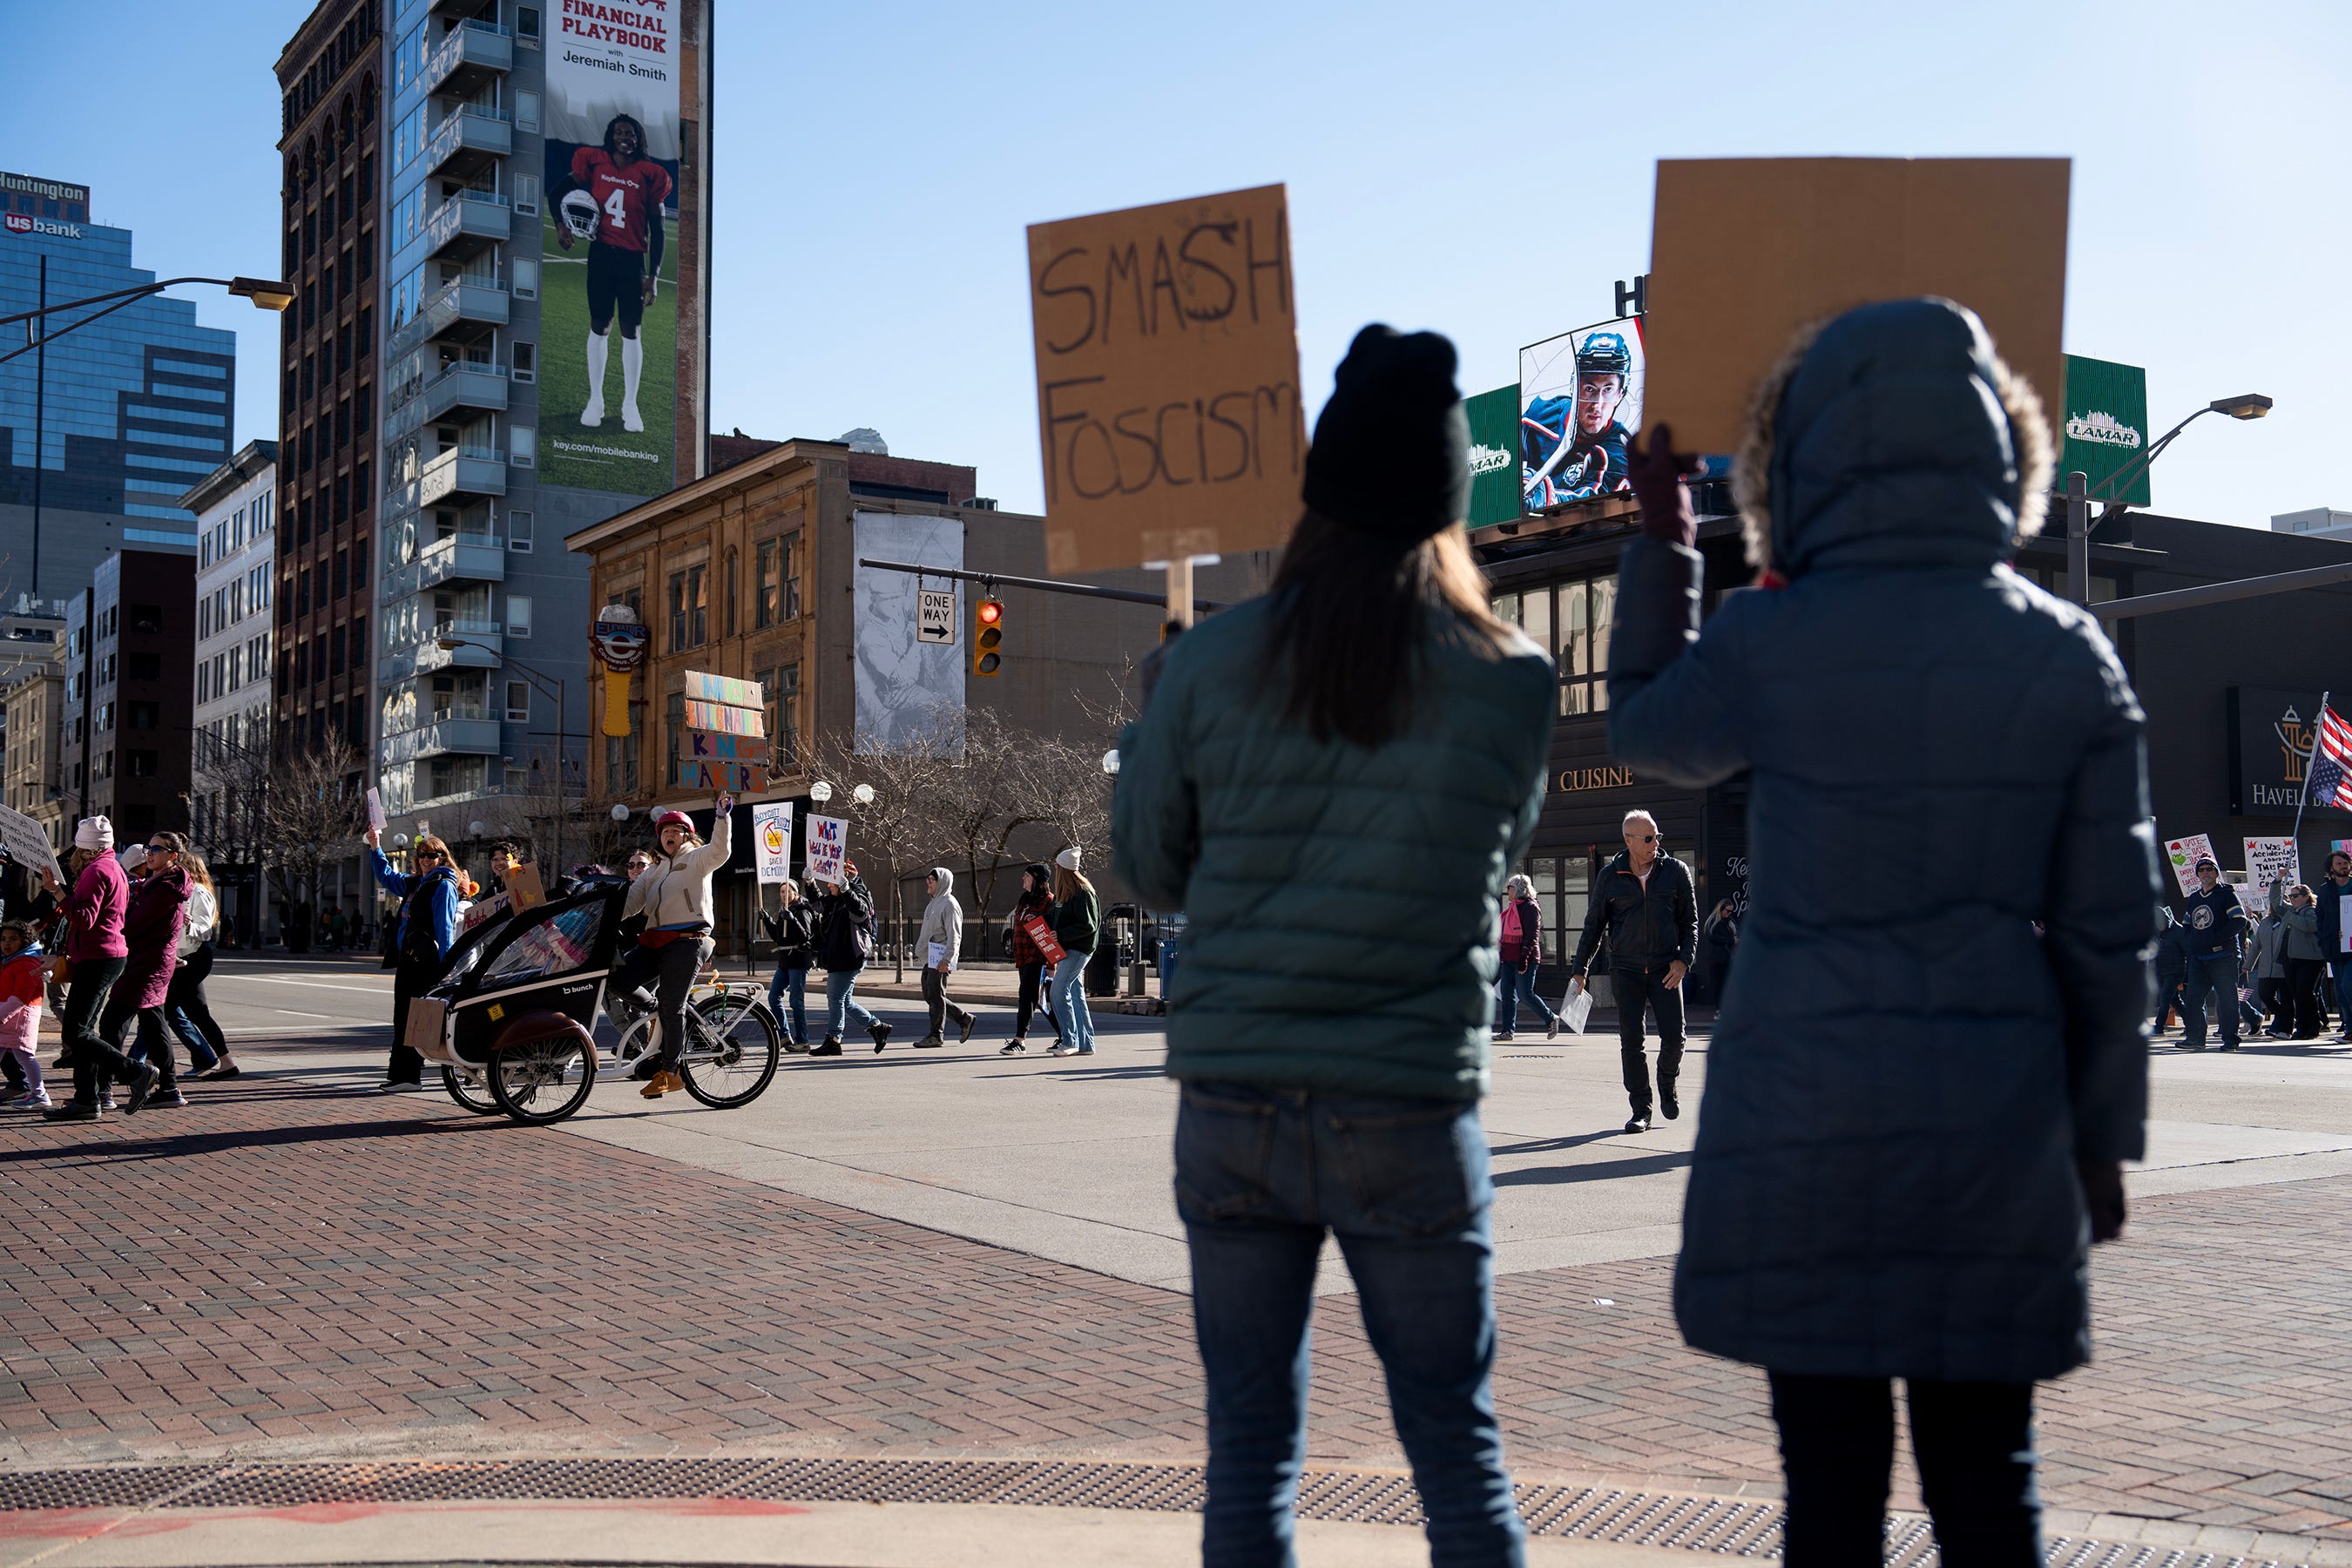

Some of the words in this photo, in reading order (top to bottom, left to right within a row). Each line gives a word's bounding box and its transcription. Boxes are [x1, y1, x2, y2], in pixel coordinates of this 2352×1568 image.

[563, 0, 666, 34] FINANCIAL
[562, 17, 666, 53] PLAYBOOK
[608, 49, 624, 57] with
[563, 50, 625, 73] Jeremiah
[629, 64, 666, 82] Smith
[601, 174, 626, 186] KeyBank
[605, 188, 626, 229] 4
[1038, 207, 1288, 355] SMASH
[2072, 425, 2134, 443] LAMAR
[553, 439, 659, 463] key.com/mobilebanking
[1469, 454, 1504, 472] MAR
[924, 594, 950, 608] ONE
[923, 608, 950, 622] WAY
[596, 622, 646, 639] ELEVATOR
[629, 650, 643, 662] OHIO
[686, 701, 763, 736] BILLIONAIRE
[693, 733, 767, 759] KING-
[681, 763, 766, 793] MAKERS
[1559, 767, 1634, 792] CUISINE
[754, 808, 779, 823] BOYCOTT
[0, 821, 22, 837] ecomes
[817, 821, 837, 841] WHAT
[2183, 837, 2202, 848] HATE
[2255, 863, 2276, 872] THIS
[1031, 924, 1045, 936] PROTECT
[571, 983, 594, 993] bunch
